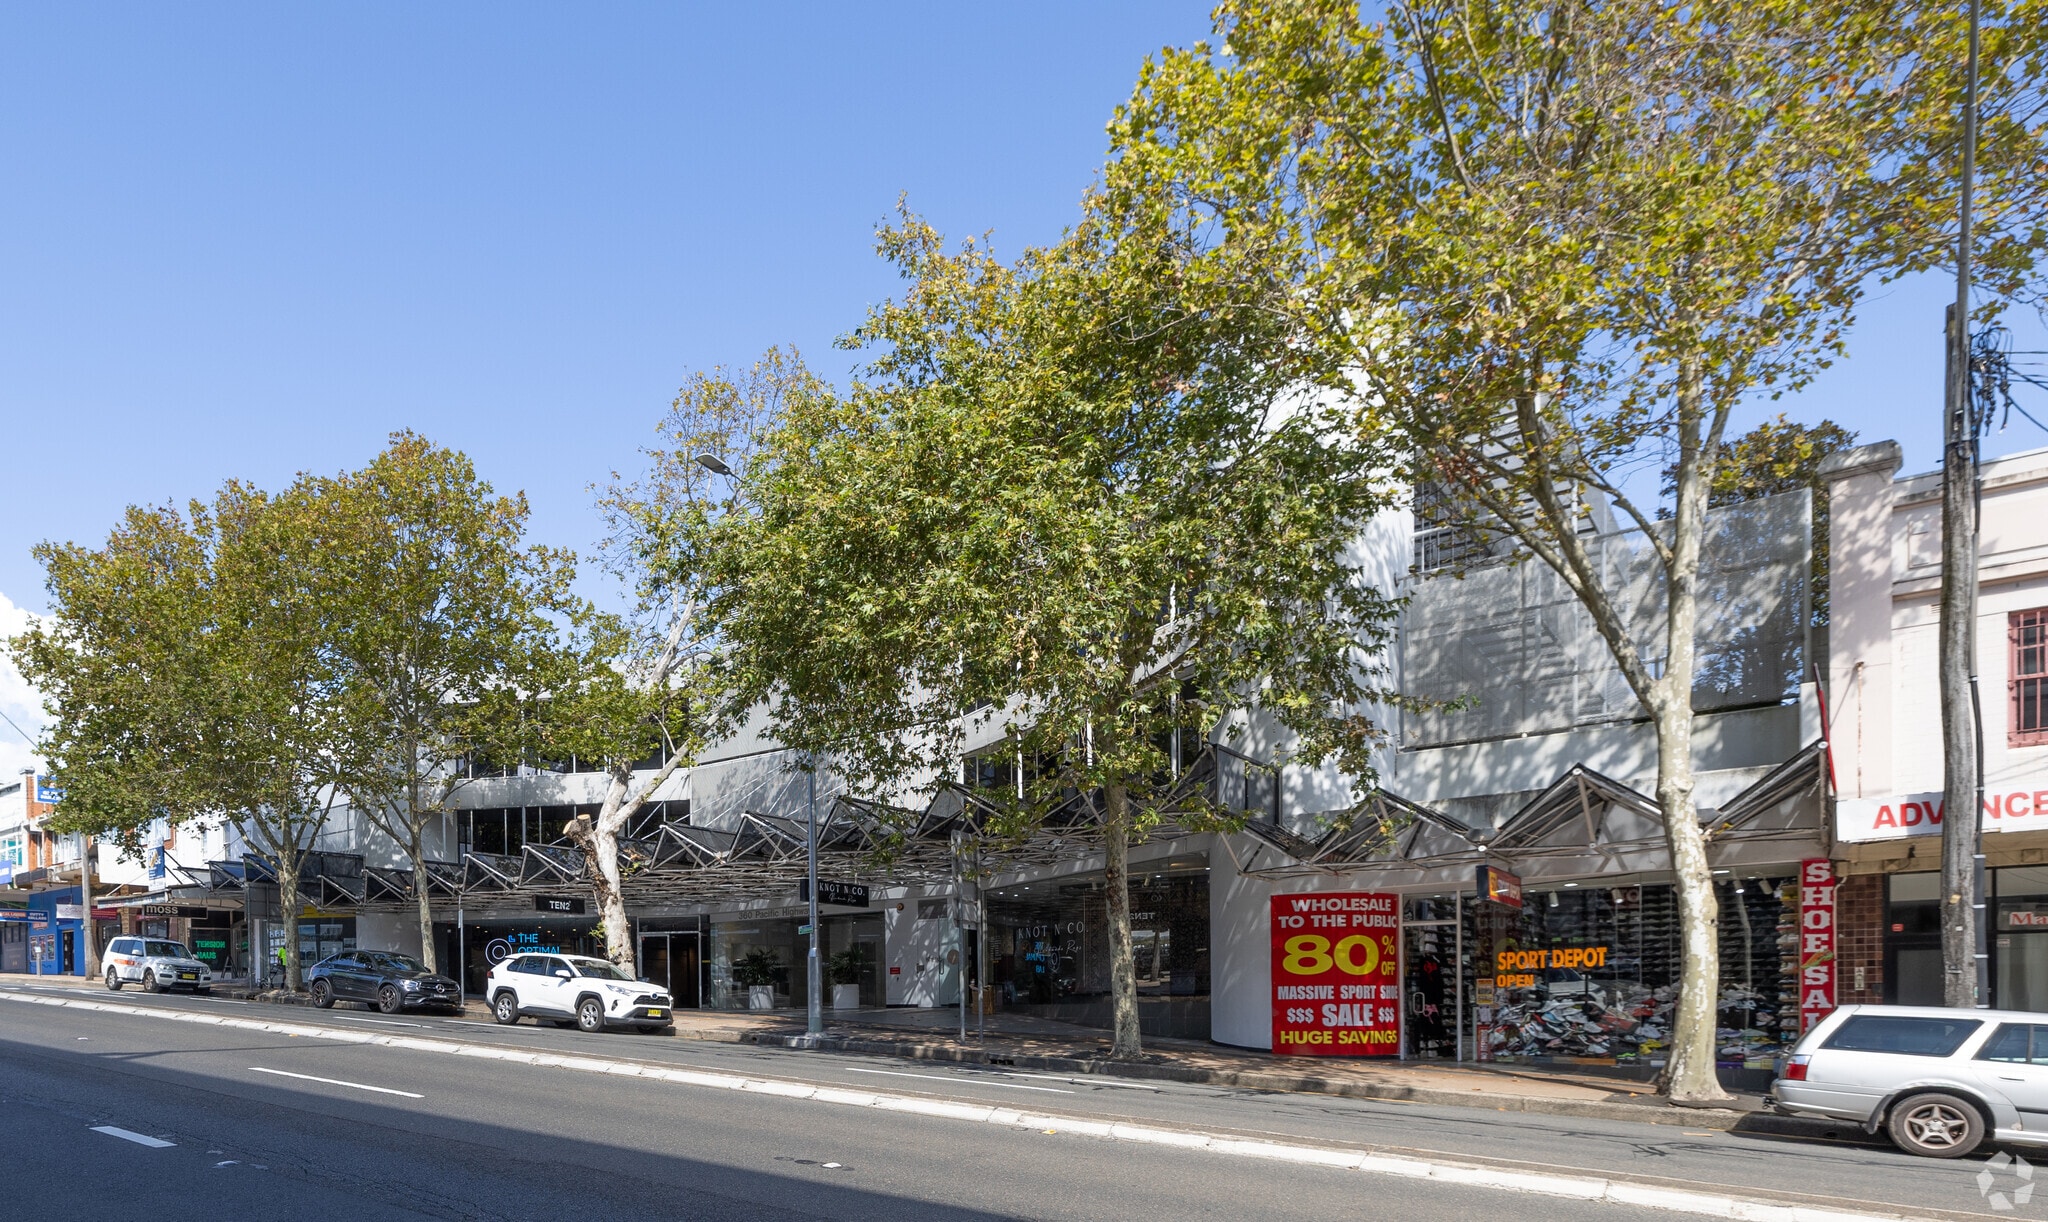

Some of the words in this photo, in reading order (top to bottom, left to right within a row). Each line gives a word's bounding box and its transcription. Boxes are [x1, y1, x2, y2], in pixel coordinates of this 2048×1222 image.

[1872, 790, 2048, 830] ADVNCE
[819, 881, 840, 892] KNOT
[843, 883, 849, 894] N
[146, 905, 178, 914] moss
[1290, 898, 1392, 912] WHOLESALE
[1802, 862, 1833, 953] SHOE
[738, 911, 752, 920] 360
[755, 910, 779, 919] Pacific
[782, 907, 810, 917] Highwa
[1278, 915, 1305, 928] TO
[1310, 914, 1347, 928] THE
[1352, 914, 1397, 928] PUBLIC
[518, 933, 539, 944] THE
[1018, 925, 1047, 940] KNOT
[1054, 923, 1061, 935] N
[196, 940, 226, 949] TENSION
[197, 951, 216, 959] HAUS
[1282, 934, 1379, 976] 80
[1381, 935, 1395, 955] %
[1497, 950, 1548, 971] SPORT
[1551, 946, 1608, 969] DEPOT
[1381, 961, 1396, 976] OFF
[1496, 974, 1534, 988] OPEN
[1277, 985, 1335, 1000] MASSIVE
[1340, 985, 1377, 999] SPORT
[1380, 985, 1398, 999] SHOE
[1322, 1003, 1374, 1027] SALE
[1280, 1030, 1333, 1045] HUGE
[1338, 1030, 1397, 1045] SAVINGS
